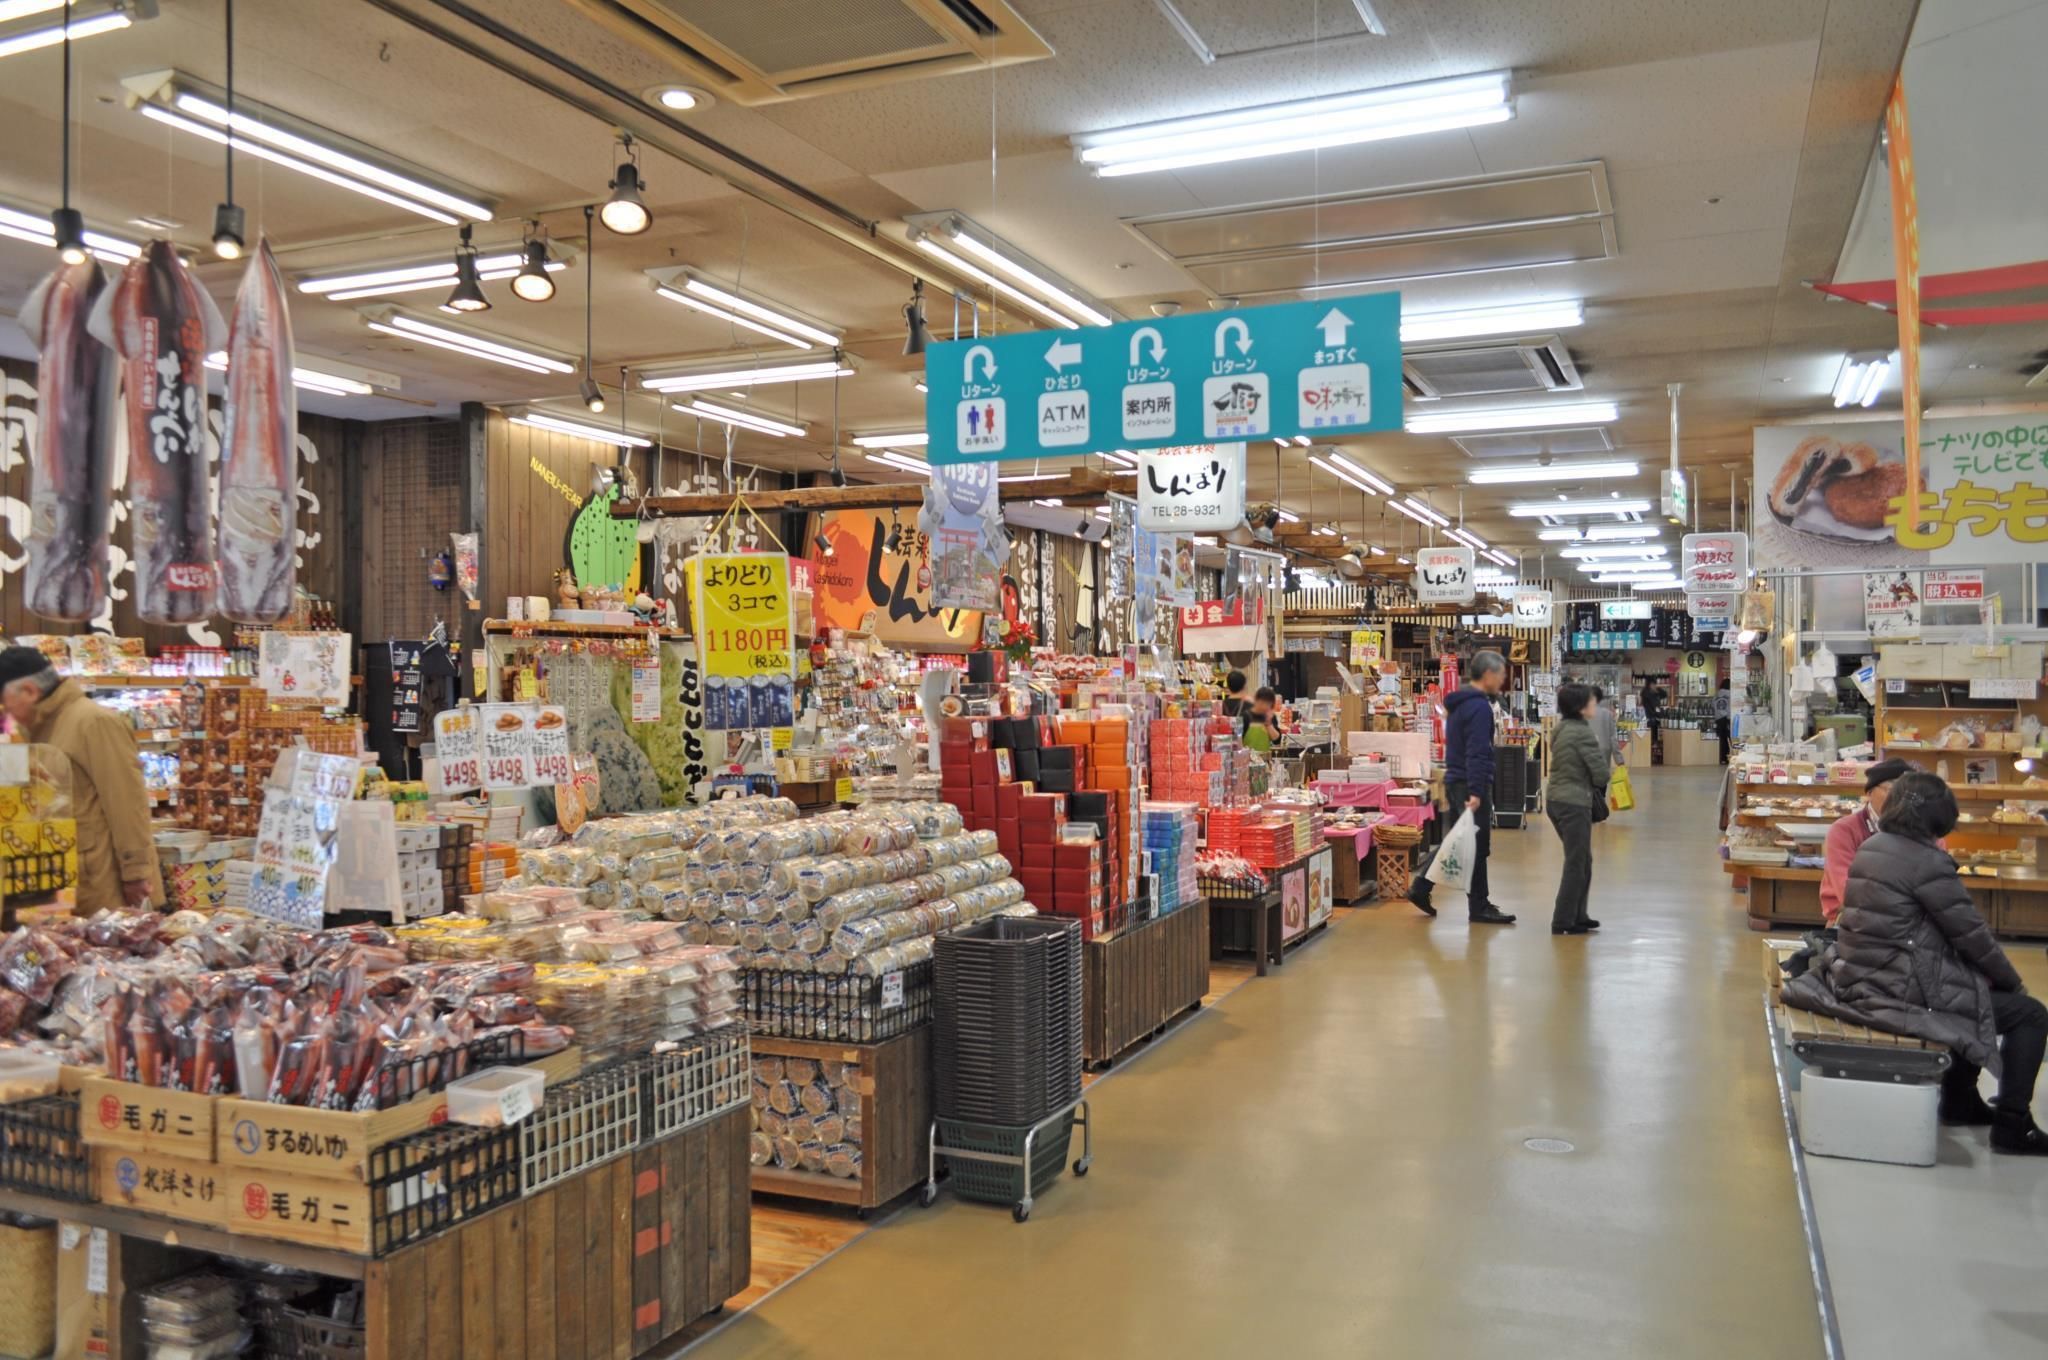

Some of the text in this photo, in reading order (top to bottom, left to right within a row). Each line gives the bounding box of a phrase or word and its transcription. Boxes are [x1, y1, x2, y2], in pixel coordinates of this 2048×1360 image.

[1211, 358, 1258, 375] Uターン
[1314, 347, 1358, 365] まっすぐ
[1044, 373, 1082, 391] ひだり
[1126, 366, 1171, 383] Uターン
[961, 382, 1001, 399] Uターン
[1042, 403, 1086, 423] ATM
[1126, 396, 1172, 415] 案内所
[964, 435, 999, 447] お手洗い
[529, 456, 584, 510] NANBU-PEAR
[705, 564, 772, 587] よりどり
[728, 593, 777, 612] 3コで
[707, 628, 787, 652] 1180円
[443, 760, 478, 787] ¥498
[487, 758, 524, 781] ¥498
[534, 755, 568, 778] ¥498
[123, 1104, 195, 1137] 毛ガニ
[265, 1128, 348, 1160] するめいか
[271, 1192, 351, 1227] 毛ガニ
